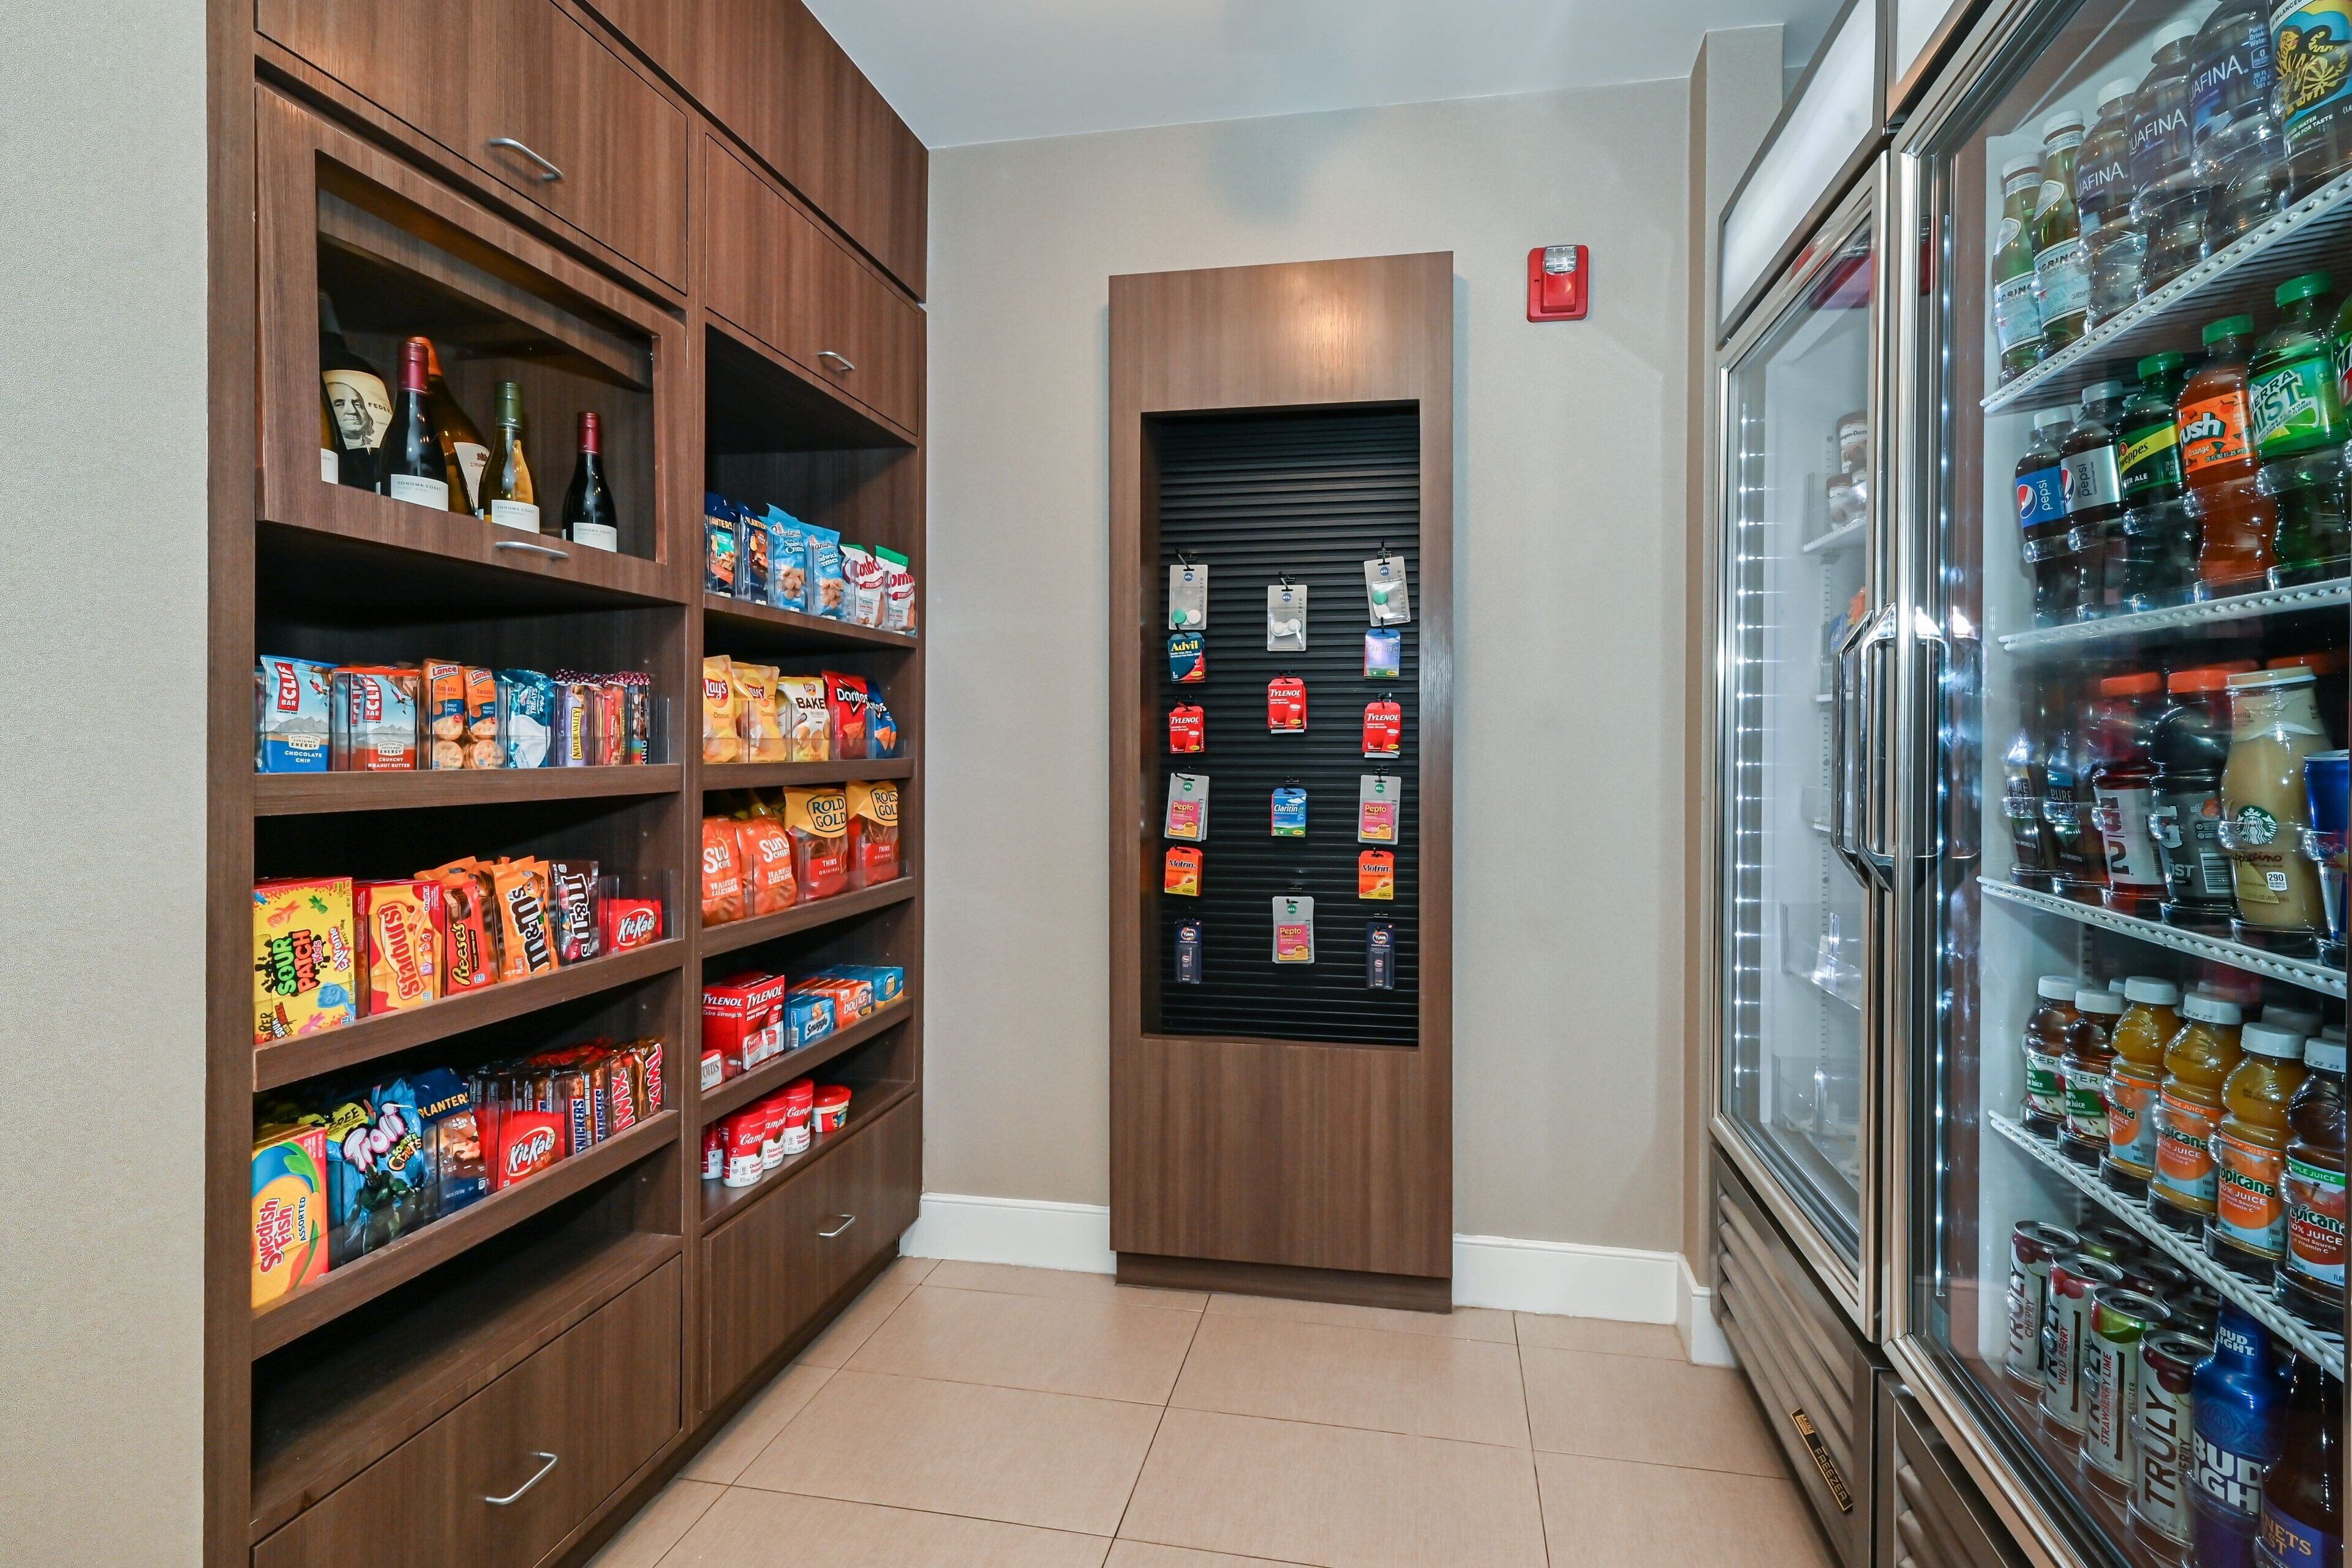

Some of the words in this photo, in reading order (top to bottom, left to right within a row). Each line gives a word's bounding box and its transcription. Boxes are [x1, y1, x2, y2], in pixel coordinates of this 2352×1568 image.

[2190, 55, 2243, 102] UAFINA
[2298, 115, 2317, 130] WATER
[2301, 124, 2312, 135] FOR
[2312, 114, 2333, 127] TASTE
[2077, 162, 2123, 198] UAFINA
[2188, 445, 2210, 457] Orange
[2076, 463, 2092, 497] pepsi
[2135, 472, 2148, 482] ALE
[2037, 479, 2053, 511] pepsi
[1170, 640, 1198, 652] Advil
[432, 666, 458, 677] Lance
[277, 666, 296, 699] CLIF
[705, 679, 727, 700] Lay's
[804, 684, 816, 692] Lay's
[364, 677, 379, 710] CLIF
[836, 688, 868, 703] Doritos
[1270, 688, 1301, 697] TYLENOL
[573, 709, 581, 736] VALLEY
[1170, 716, 1199, 725] TYLENOL
[1366, 713, 1399, 722] TYLENOL
[573, 736, 581, 758] NATURE
[2007, 781, 2029, 793] PURE
[2051, 789, 2073, 802] PURE
[812, 798, 845, 814] ROLD
[1173, 802, 1194, 812] Pepto
[1365, 804, 1387, 813] Pepto
[816, 812, 846, 827] GOLD
[818, 867, 840, 875] ORIGINAL
[1168, 859, 1194, 869] Motrin
[1362, 864, 1389, 873] Motrin
[2268, 873, 2284, 882] 290
[1280, 927, 1302, 937] Pepto
[312, 940, 324, 964] Kids
[379, 905, 420, 997] Starburst
[451, 923, 471, 986] Reese's
[273, 937, 296, 995] SOUR
[292, 929, 318, 994] PATCH
[703, 993, 743, 1008] TYLENOL
[746, 986, 783, 1011] TYLENOL
[807, 1017, 828, 1036] Snuggle
[645, 1043, 663, 1112] TWIX
[2032, 1080, 2043, 1088] Juice
[612, 1069, 636, 1132] TWIX
[2071, 1099, 2086, 1109] Juice
[2182, 1102, 2205, 1114] JUICE
[573, 1099, 586, 1153] SNICKERS
[2113, 1115, 2129, 1126] JUICE
[344, 1102, 405, 1172] Trolli
[2173, 1144, 2201, 1159] JUICE
[2220, 1166, 2276, 1199] opicana
[2309, 1170, 2337, 1183] JUICE
[2226, 1200, 2248, 1212] Vitamin
[2234, 1191, 2267, 1206] JUICE
[2239, 1199, 2261, 1210] Source
[255, 1198, 279, 1273] Swedish
[274, 1205, 293, 1251] Fish
[2306, 1229, 2343, 1246] JUICE
[2312, 1239, 2337, 1251] Source
[2297, 1240, 2323, 1253] Vitamin
[2024, 1297, 2040, 1338] CHERRY
[2059, 1324, 2070, 1357] BERRY
[2219, 1325, 2248, 1346] BUD
[2057, 1355, 2068, 1385] WILD
[2103, 1351, 2112, 1382] LIME
[2098, 1383, 2112, 1448] STRAWBERRY
[2146, 1384, 2177, 1510] TRULY
[2193, 1432, 2262, 1485] BUD
[1814, 1447, 1847, 1501] FREEZER
